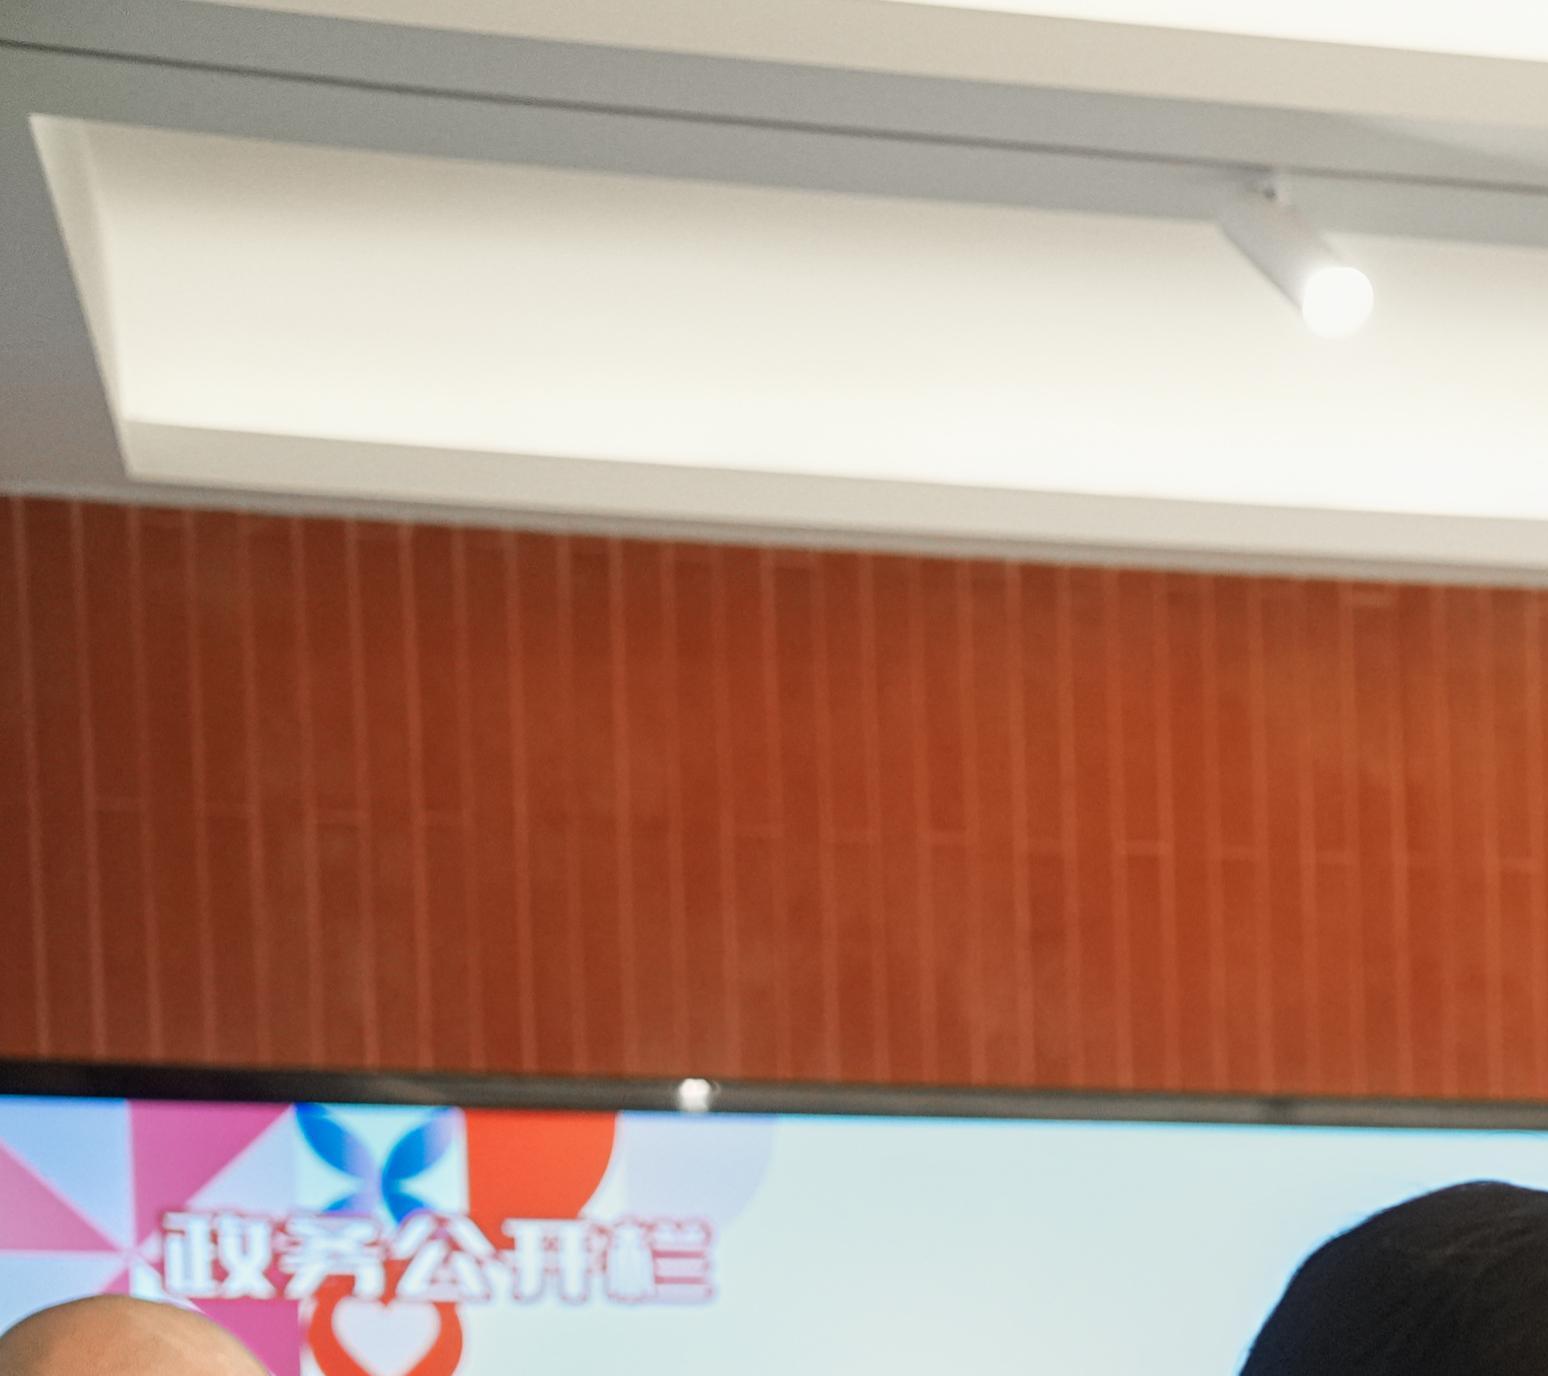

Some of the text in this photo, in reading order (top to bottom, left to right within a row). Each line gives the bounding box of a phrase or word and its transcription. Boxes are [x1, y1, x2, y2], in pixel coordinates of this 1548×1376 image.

[163, 1209, 716, 1302] 政务公开栏
